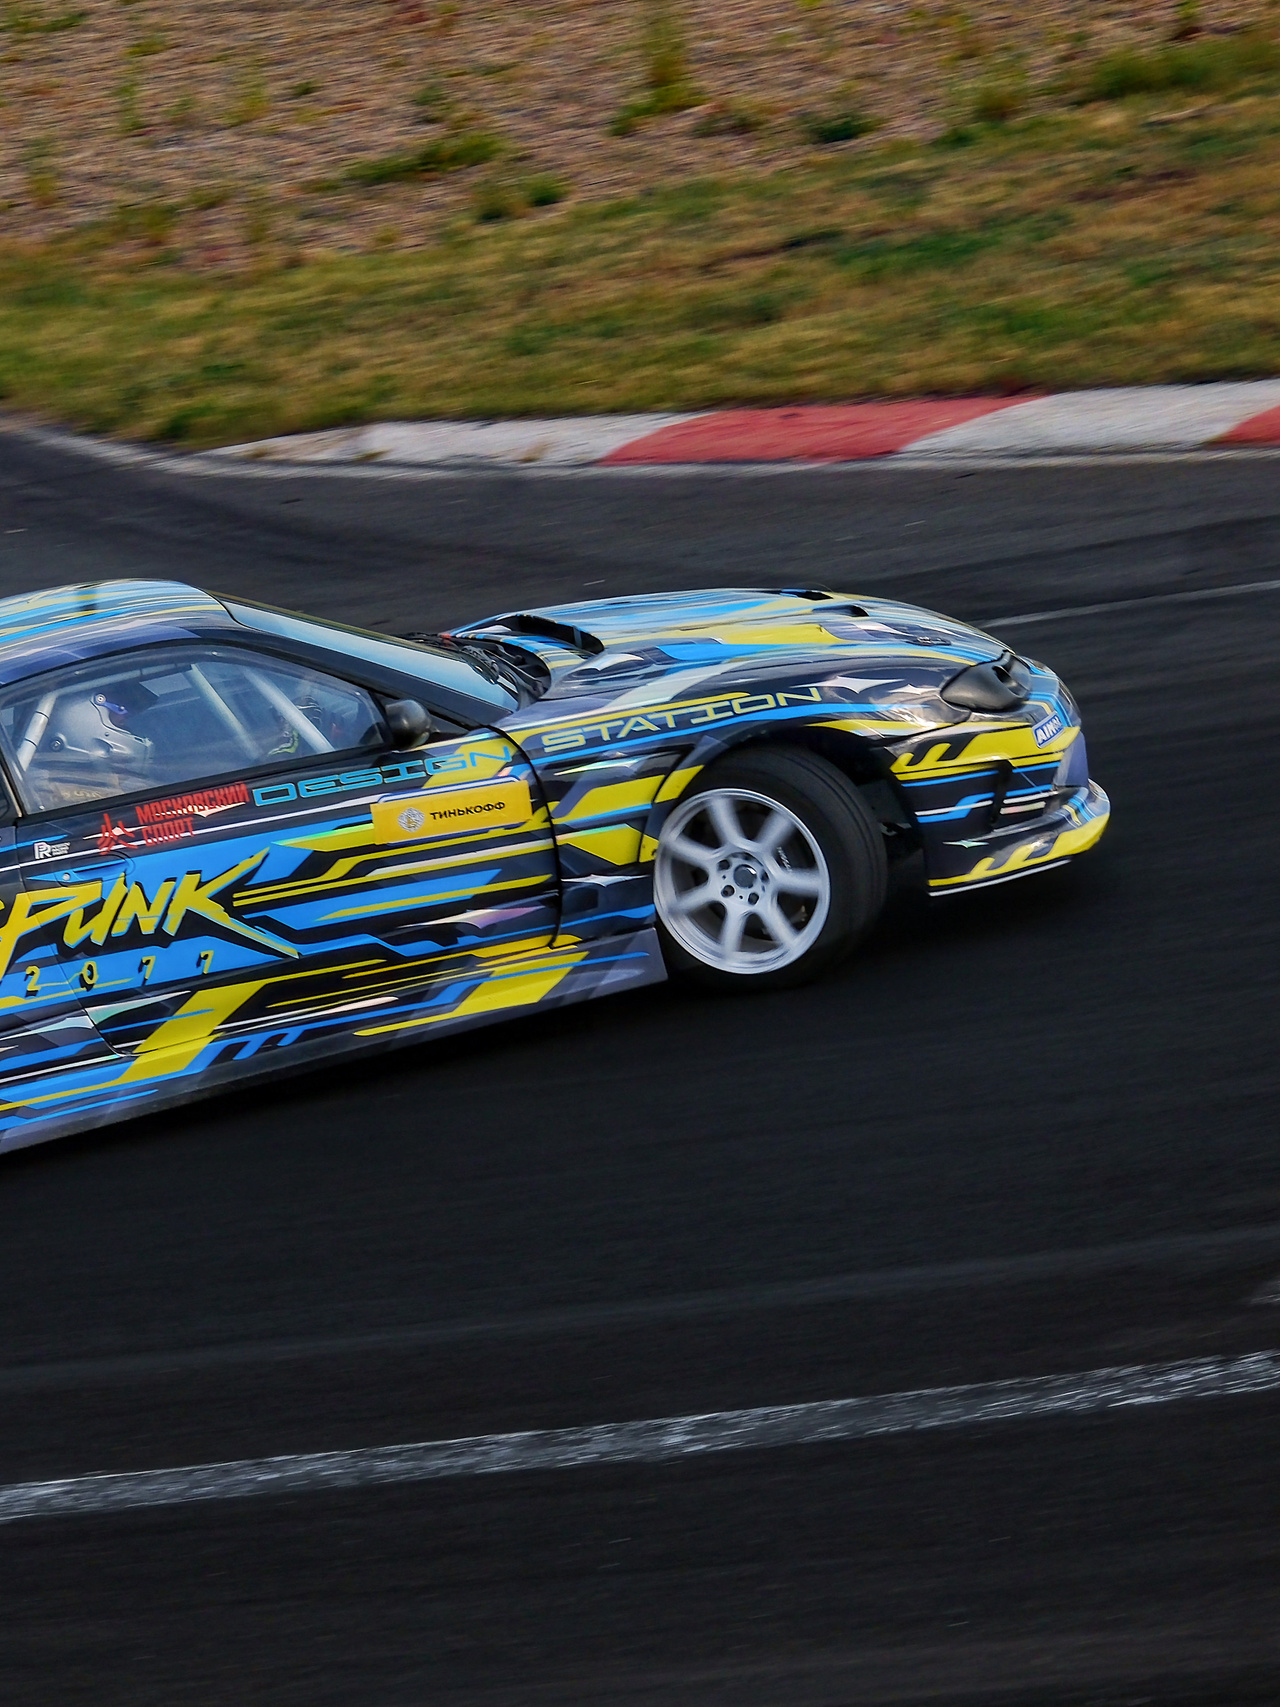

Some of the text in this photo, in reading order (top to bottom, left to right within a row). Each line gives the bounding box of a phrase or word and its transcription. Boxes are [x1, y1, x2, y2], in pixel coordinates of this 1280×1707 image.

[252, 687, 823, 807] DESIGN STATION
[429, 801, 506, 820] ТИНЬКОФФ
[141, 817, 195, 847] СПОРТ
